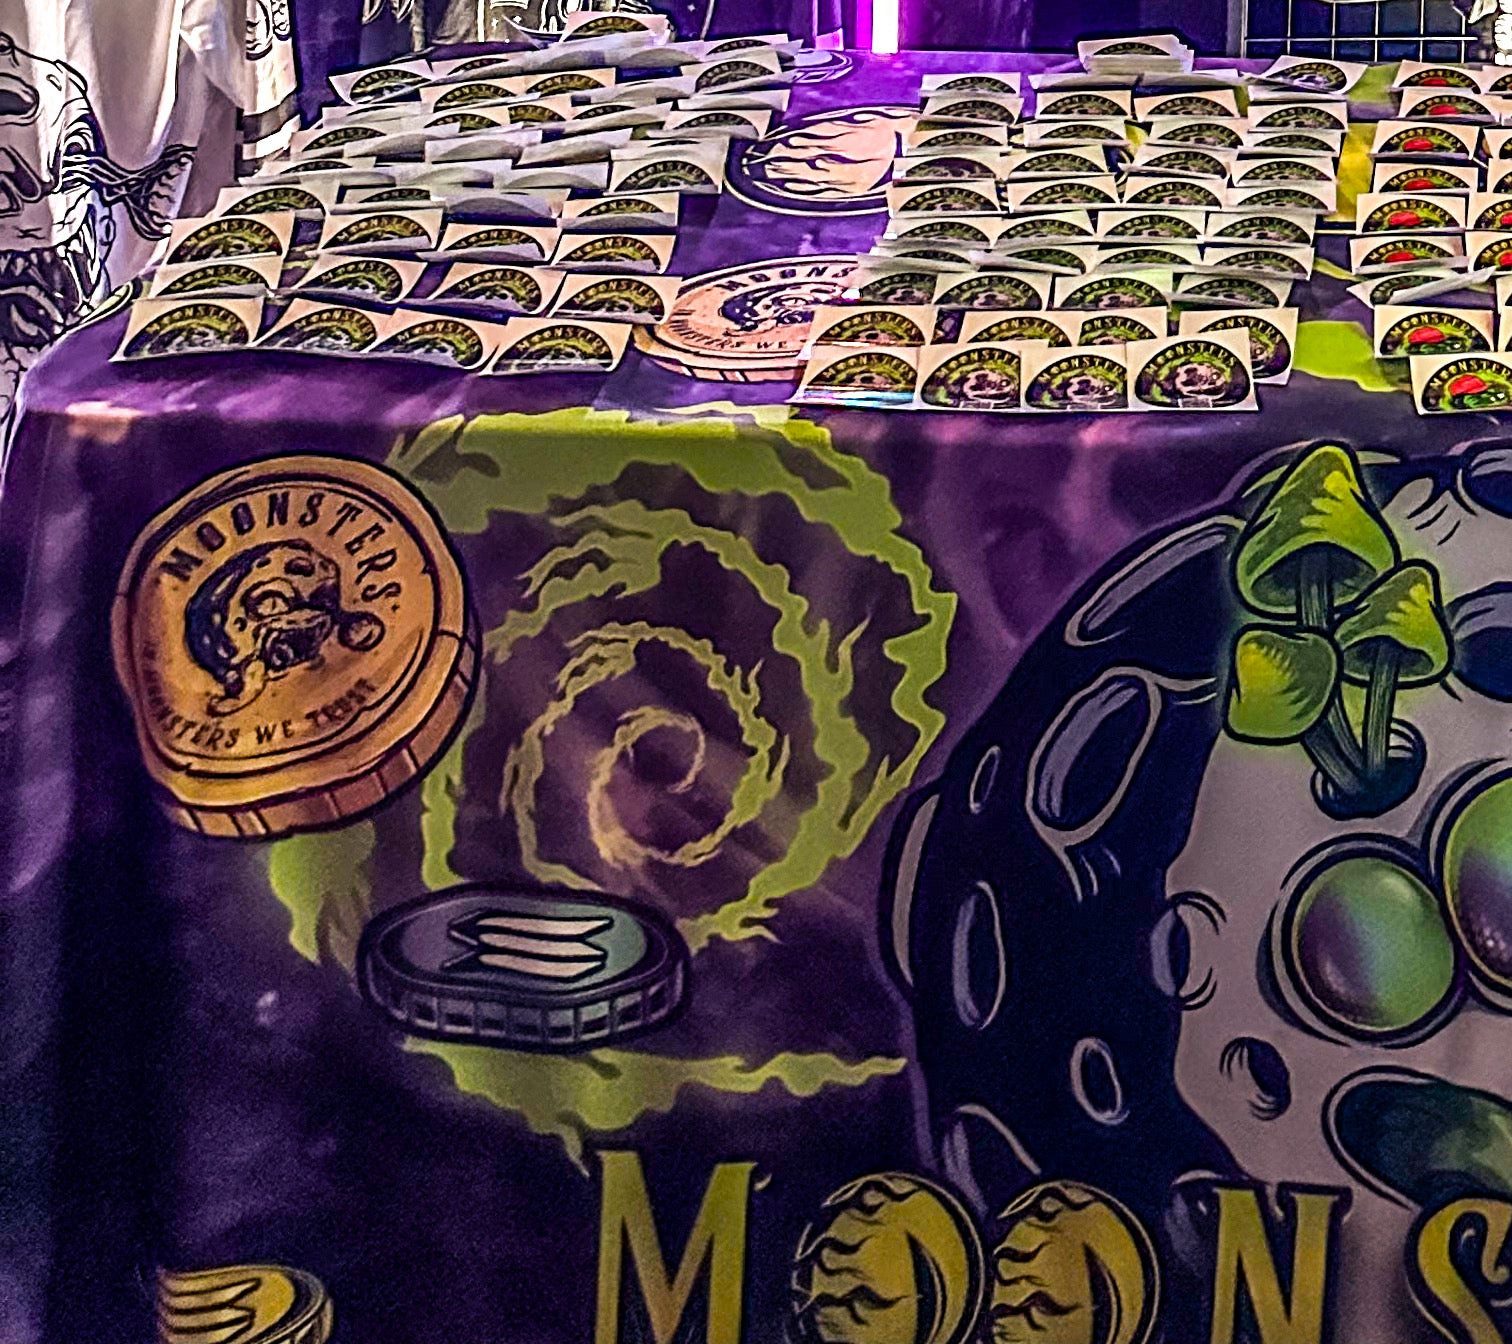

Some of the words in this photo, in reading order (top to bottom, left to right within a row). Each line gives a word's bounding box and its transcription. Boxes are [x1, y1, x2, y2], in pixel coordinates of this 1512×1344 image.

[1389, 313, 1478, 343] MOONSTERS
[160, 492, 401, 603] MOONSTERS
[255, 720, 295, 745] WE
